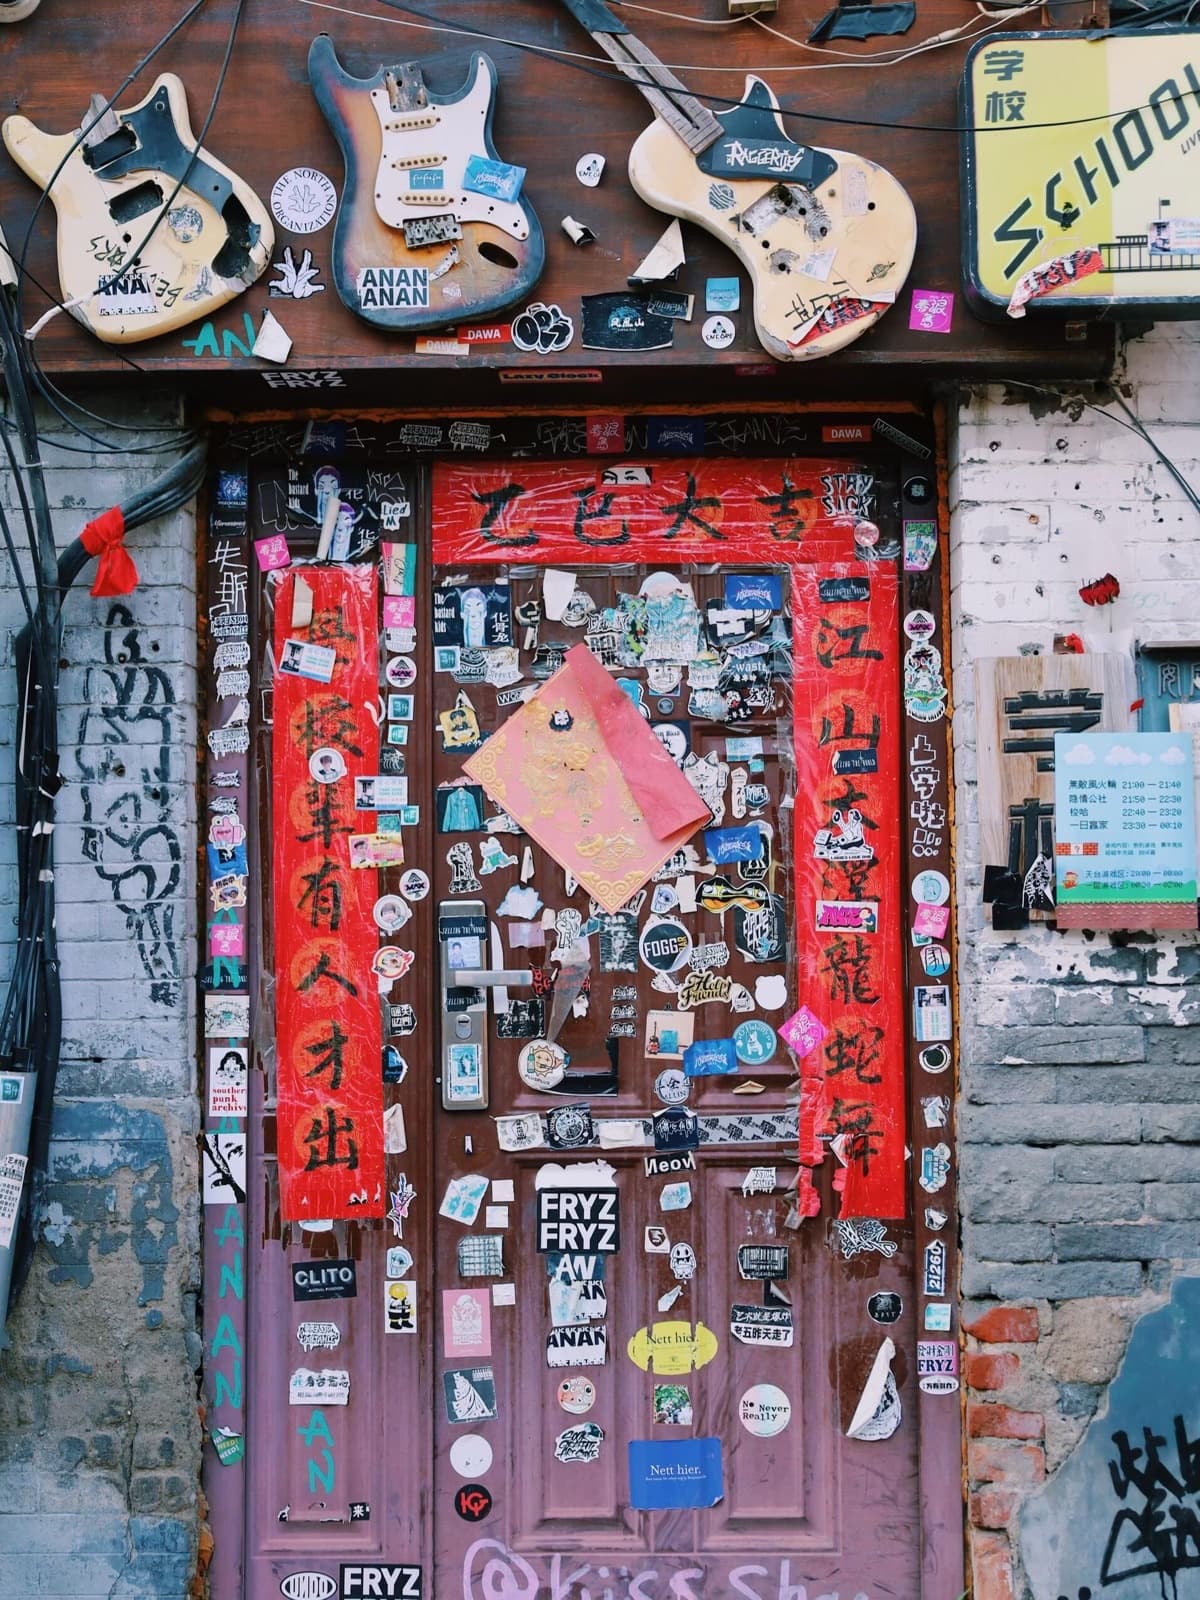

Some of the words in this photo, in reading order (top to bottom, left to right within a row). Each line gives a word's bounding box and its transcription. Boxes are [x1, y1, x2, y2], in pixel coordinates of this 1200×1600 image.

[984, 50, 1027, 122] 学校
[272, 174, 292, 198] THE
[294, 168, 332, 194] NORTH
[273, 193, 336, 231] ORGANIZATION
[362, 269, 428, 287] ANAN
[362, 287, 428, 306] ANAN
[468, 328, 501, 340] DAWA
[261, 371, 342, 380] FRYZ
[269, 380, 347, 388] FRYZ
[503, 373, 544, 381] Lazy
[831, 428, 863, 440] DAWA
[821, 473, 875, 496] STAY
[471, 471, 814, 547] 乙巳大吉
[823, 496, 876, 519] SICK
[434, 593, 445, 605] The
[434, 606, 456, 618] bastard
[434, 620, 447, 633] kids
[491, 611, 511, 643] 化骨龙
[644, 940, 678, 958] FOGG
[212, 1095, 237, 1104] punk
[541, 1193, 616, 1220] FRYZ
[541, 1223, 616, 1250] FRYZ
[295, 1267, 352, 1287] CLITO
[734, 1326, 791, 1342] 老五昨天走了
[918, 1359, 954, 1372] FRYZ
[742, 1411, 778, 1422] Really
[759, 1404, 790, 1413] Never
[651, 1465, 674, 1475] Nett
[677, 1464, 701, 1475] hier.
[344, 1567, 420, 1596] FRYZ
